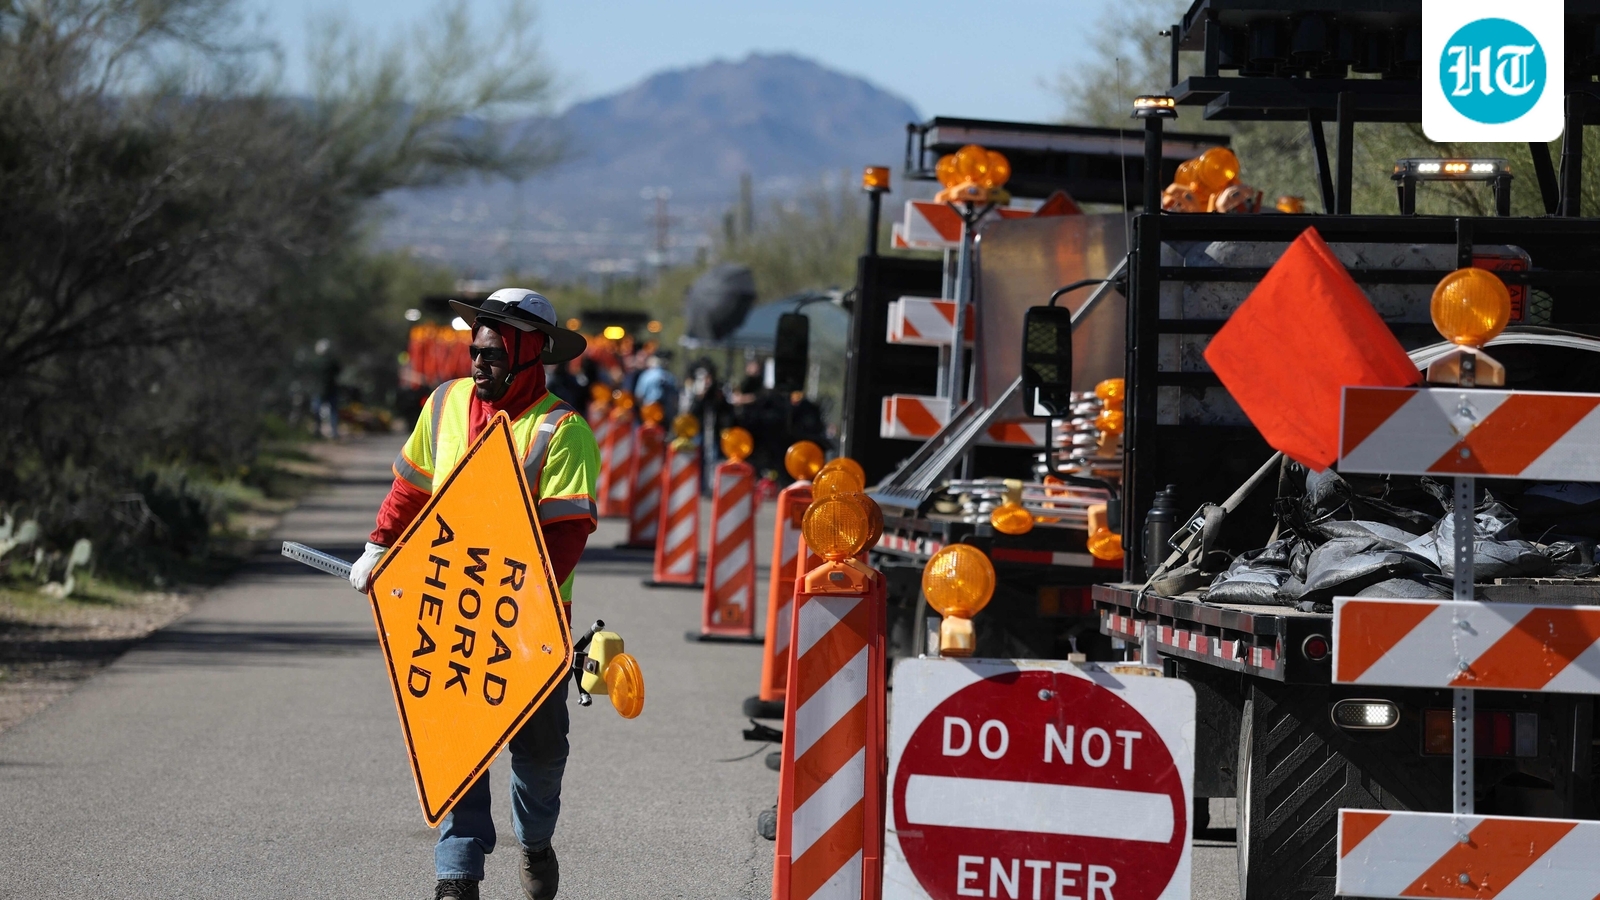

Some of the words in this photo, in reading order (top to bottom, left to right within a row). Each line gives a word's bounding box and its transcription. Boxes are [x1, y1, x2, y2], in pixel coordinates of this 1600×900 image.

[407, 513, 455, 699] AHEAD
[444, 547, 490, 697] WORK
[483, 557, 527, 706] ROAD
[942, 716, 1009, 760] DO
[1043, 723, 1142, 770] NOT
[957, 855, 1117, 900] ENTER
